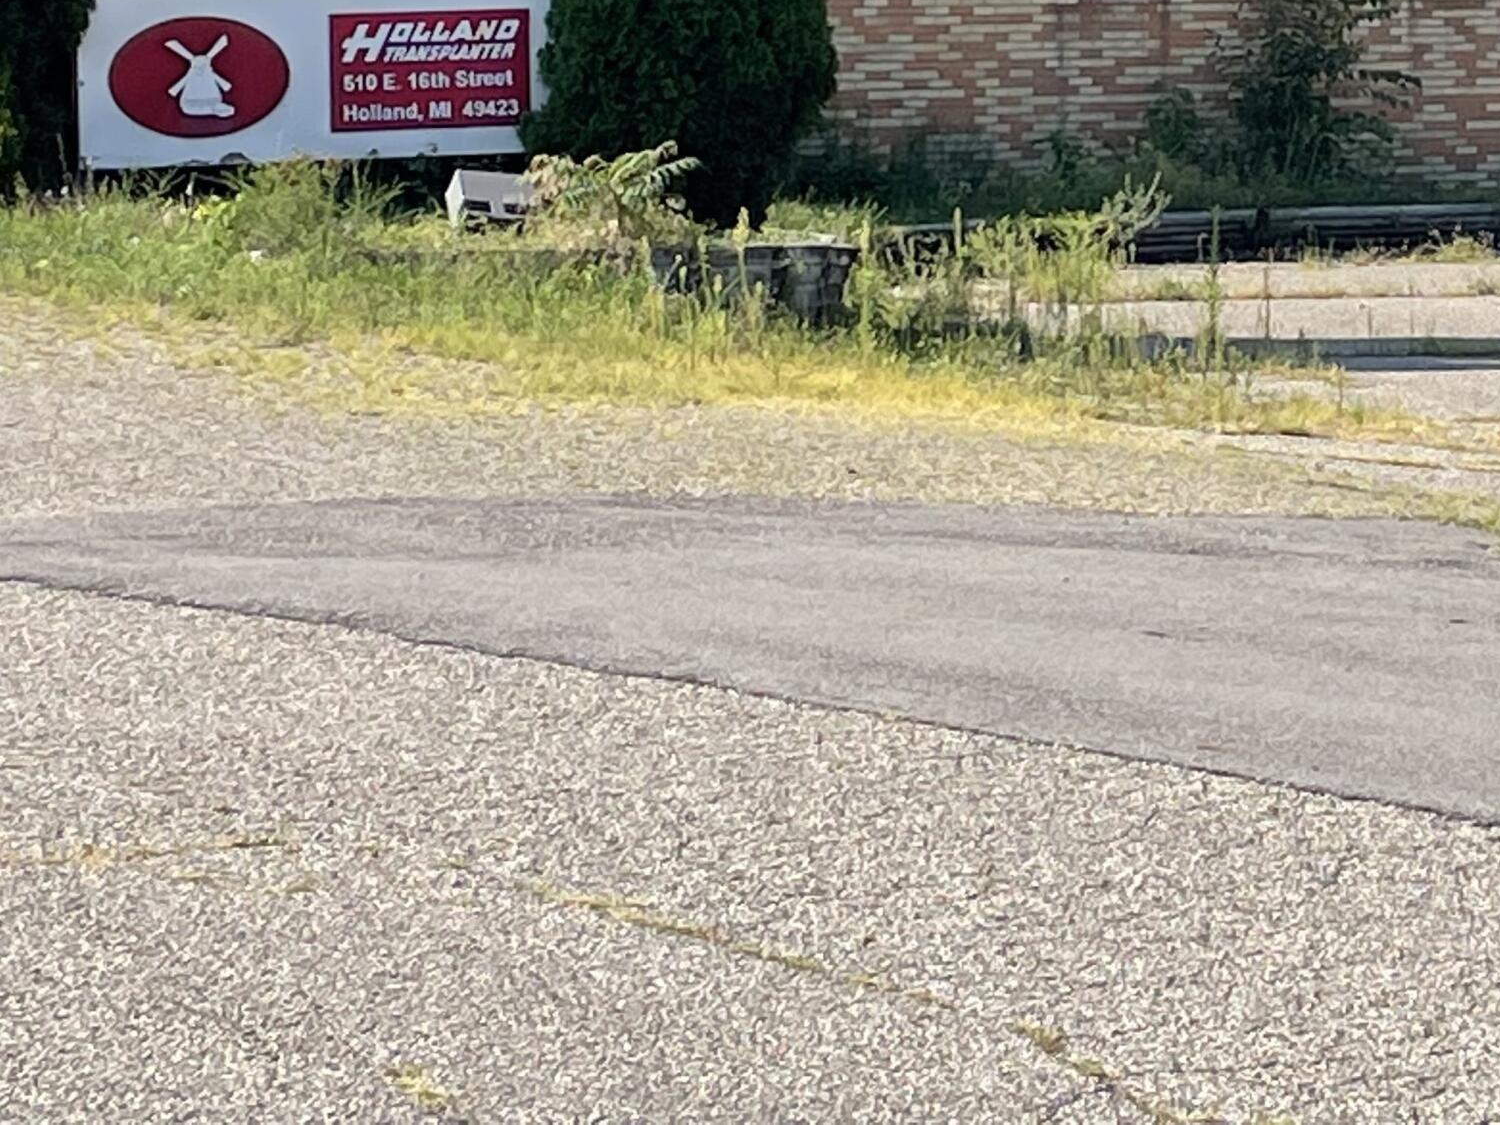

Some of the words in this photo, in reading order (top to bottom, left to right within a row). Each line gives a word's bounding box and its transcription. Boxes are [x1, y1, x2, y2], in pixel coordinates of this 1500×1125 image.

[341, 18, 520, 63] HOLLAND
[383, 42, 516, 63] TRANSPLANTER
[343, 74, 377, 92] 510
[383, 72, 400, 91] E.
[407, 71, 450, 91] 16th
[455, 68, 514, 89] Street
[342, 101, 424, 122] Holland,
[429, 100, 452, 119] MI
[462, 98, 519, 117] 49423
